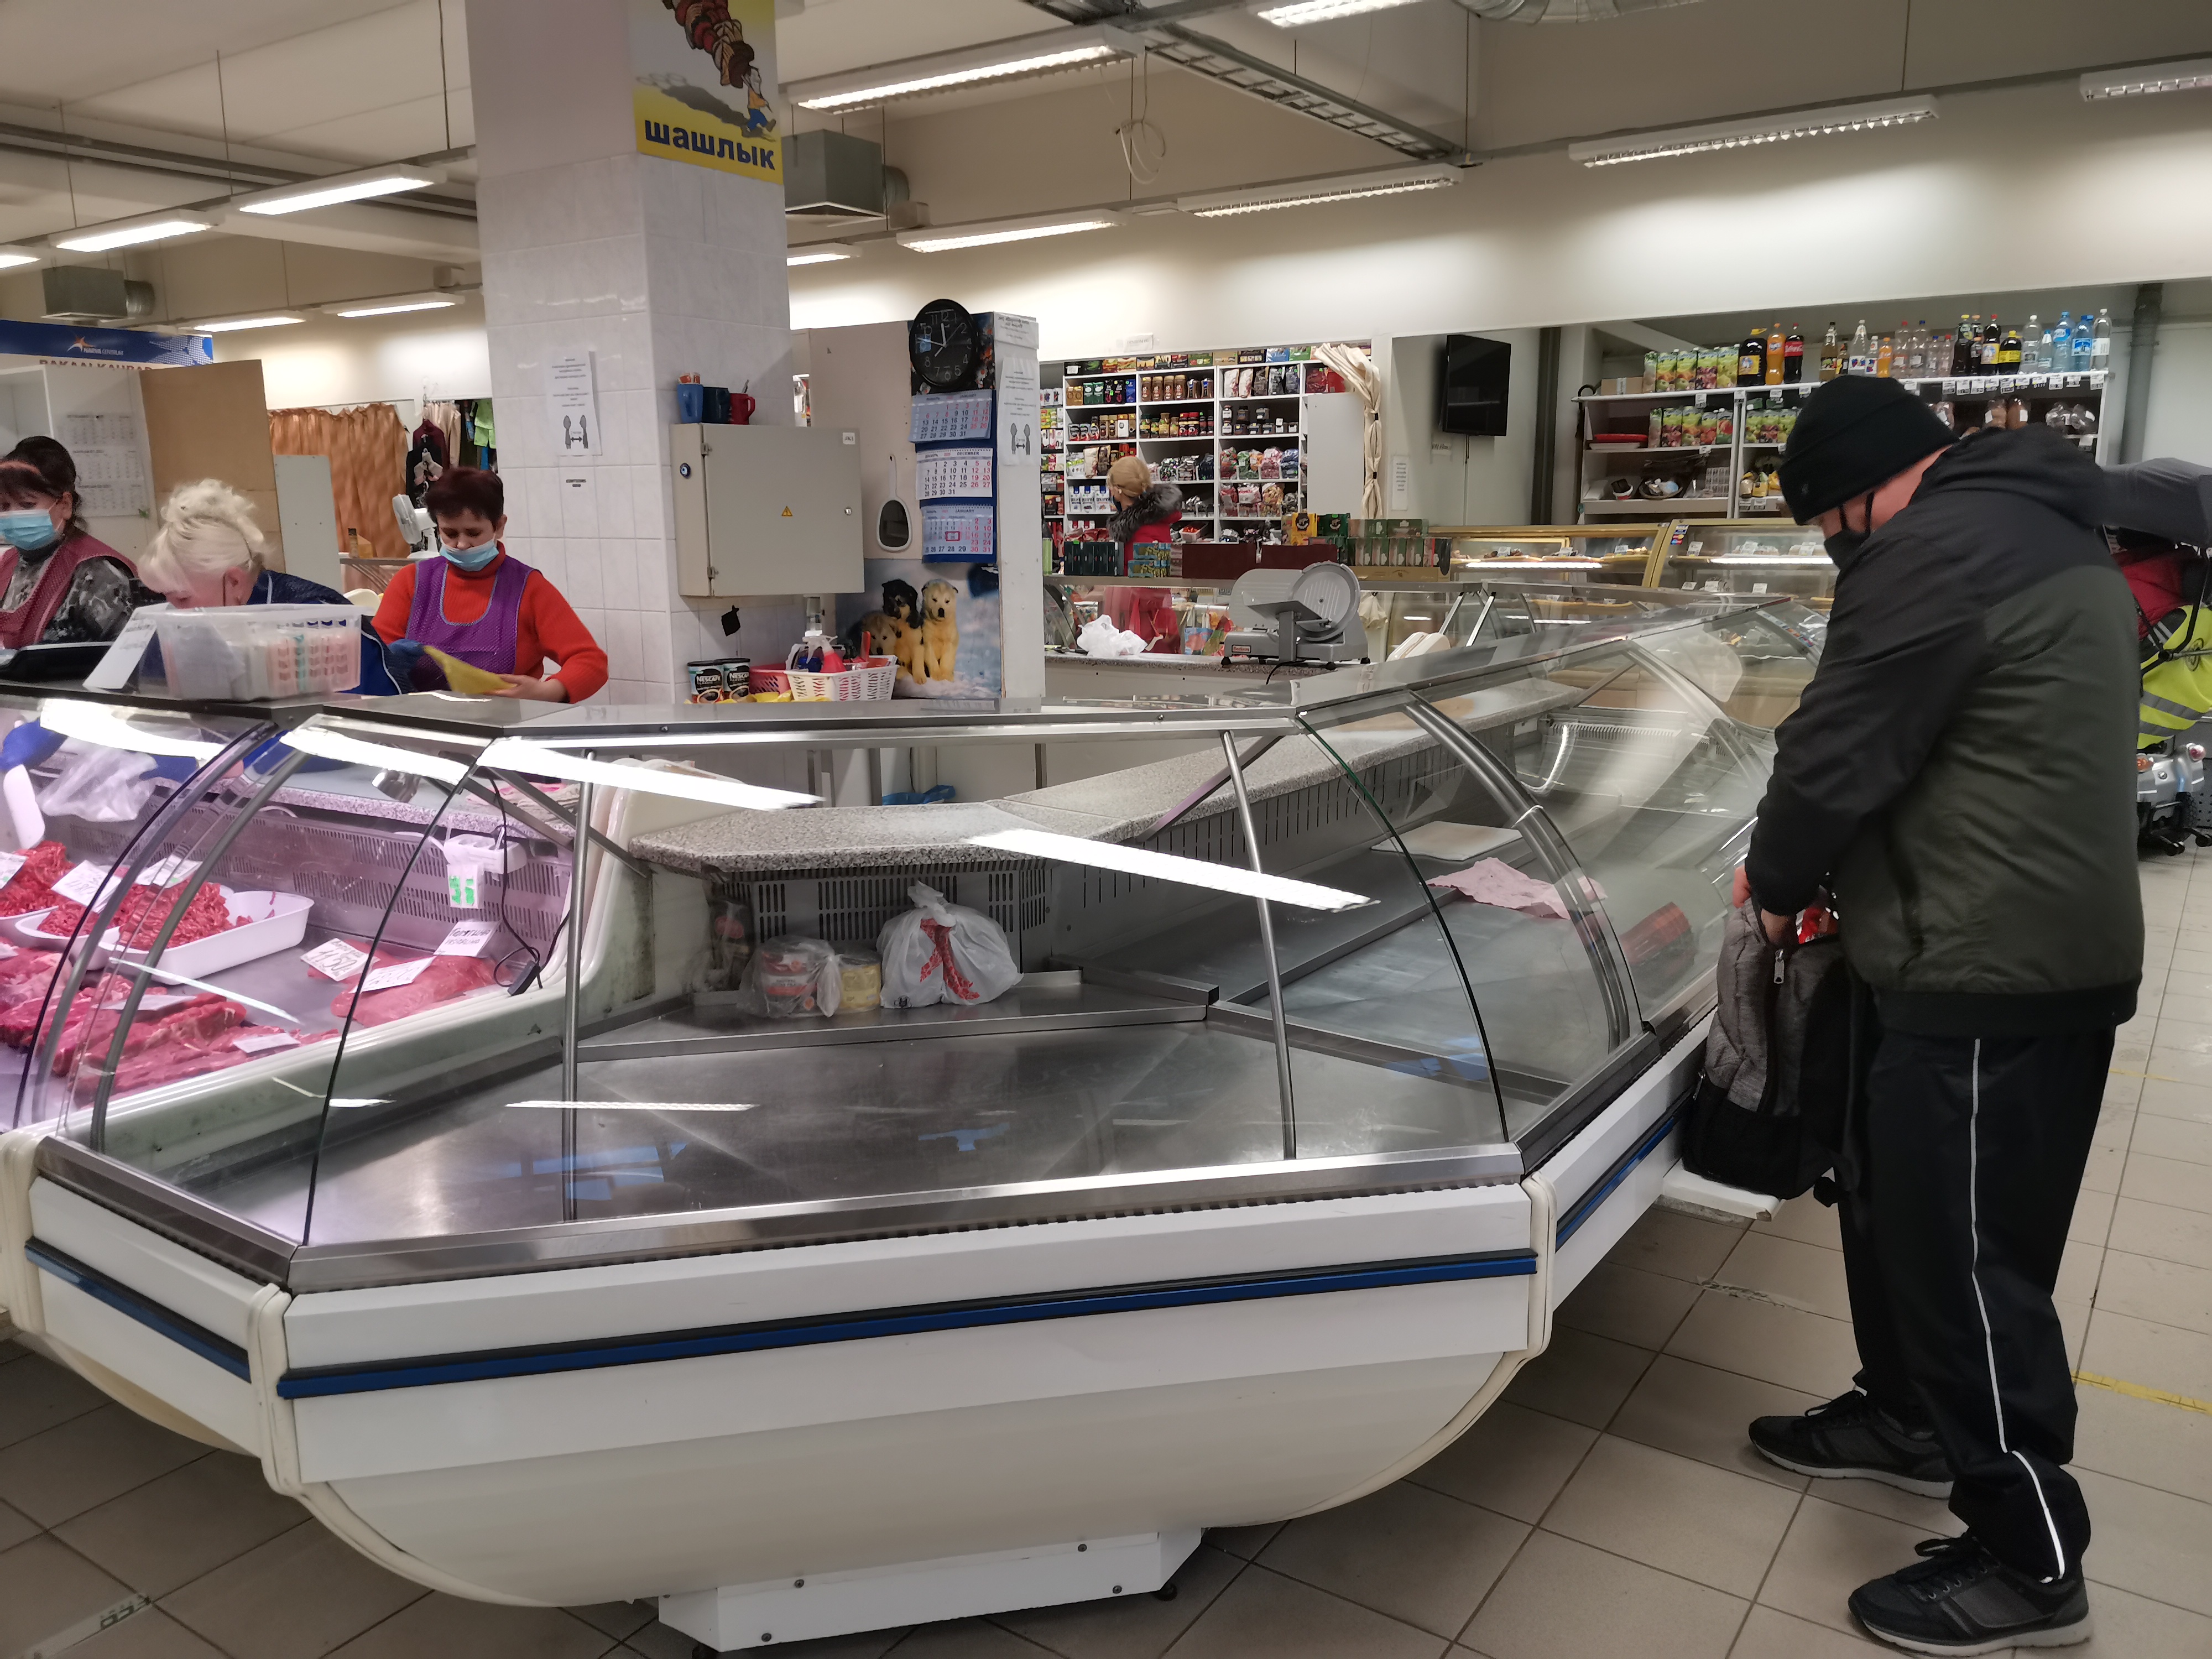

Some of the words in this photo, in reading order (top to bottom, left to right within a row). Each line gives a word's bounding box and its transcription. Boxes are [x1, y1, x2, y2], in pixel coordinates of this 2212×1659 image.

[645, 120, 775, 170] шашлык
[925, 357, 930, 367] 8
[963, 354, 968, 364] 4
[935, 367, 940, 377] 7
[954, 366, 961, 376] 5
[945, 371, 951, 382] 6
